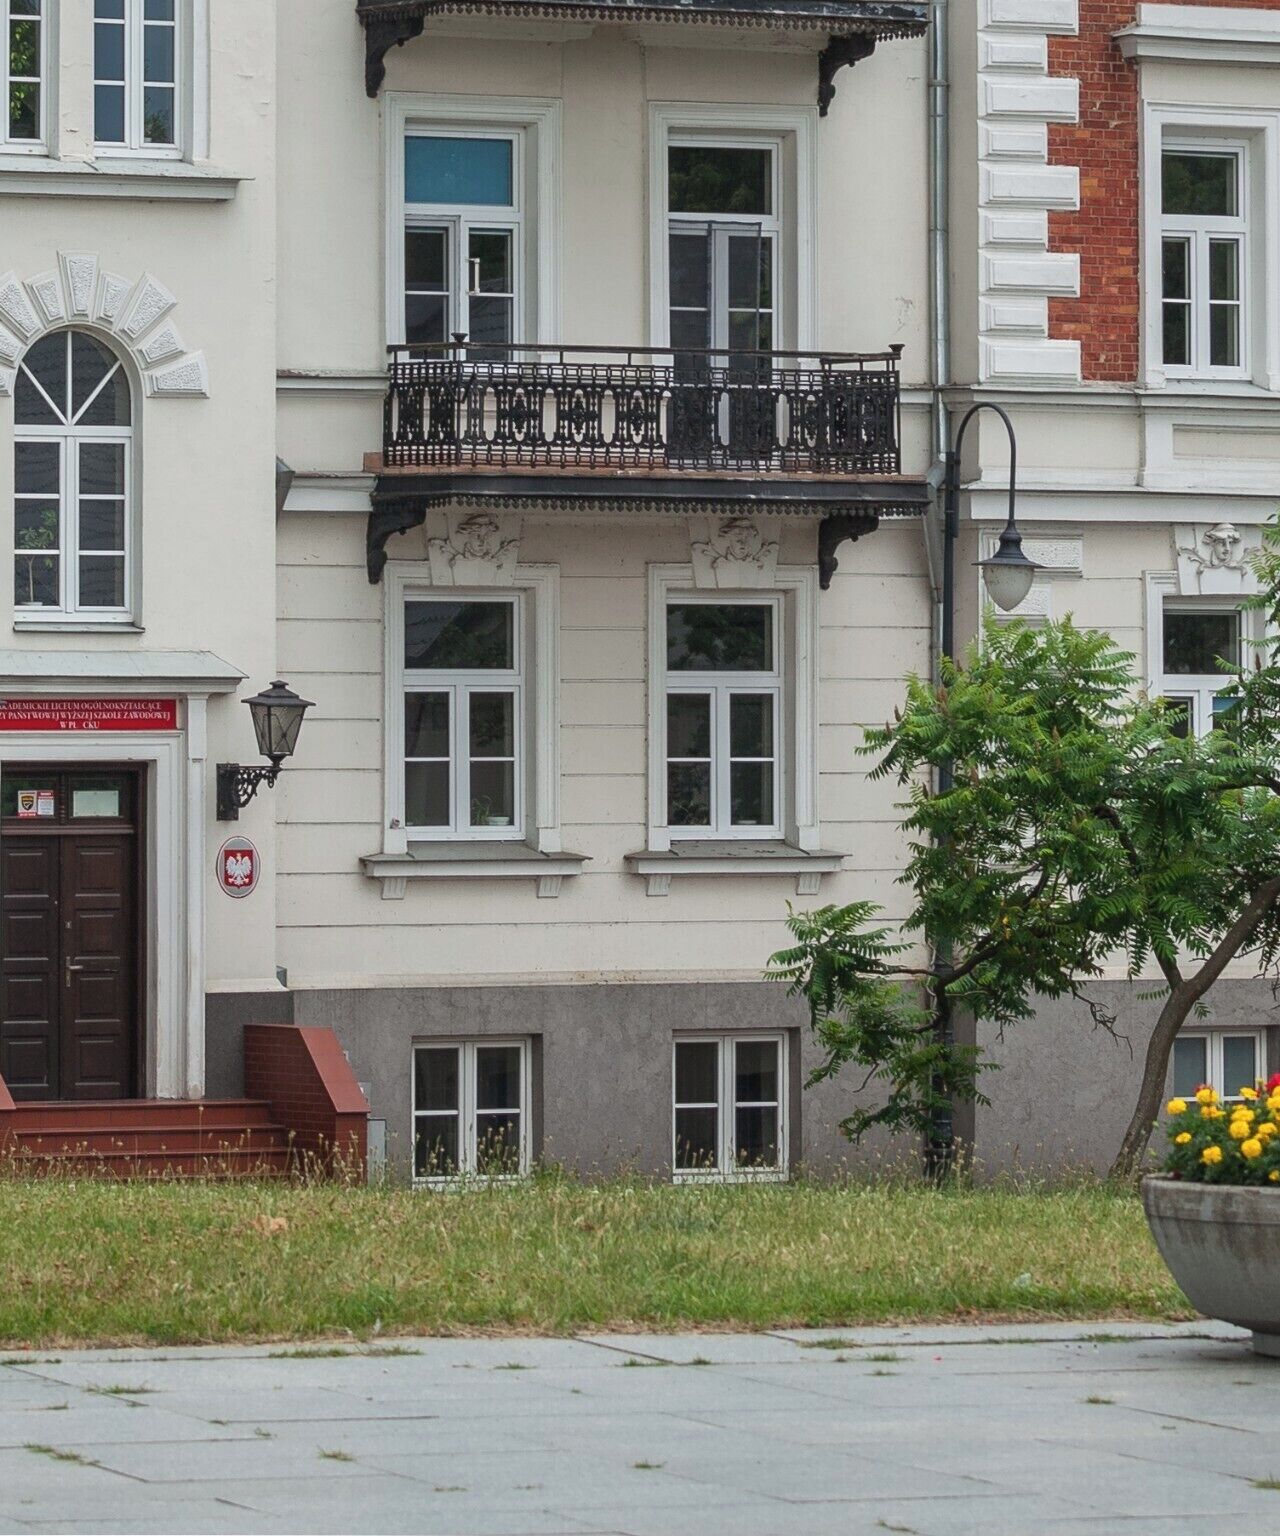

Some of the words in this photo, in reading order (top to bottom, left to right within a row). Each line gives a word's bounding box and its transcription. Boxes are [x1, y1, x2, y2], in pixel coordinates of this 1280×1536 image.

[51, 702, 80, 710] LICEUM
[8, 710, 60, 722] PAŃSTWOWEJ
[60, 710, 93, 721] WYŻSZEJ
[93, 711, 122, 720] SZKOLE
[123, 711, 171, 721] ZAWODOWEJ
[59, 721, 67, 729] W
